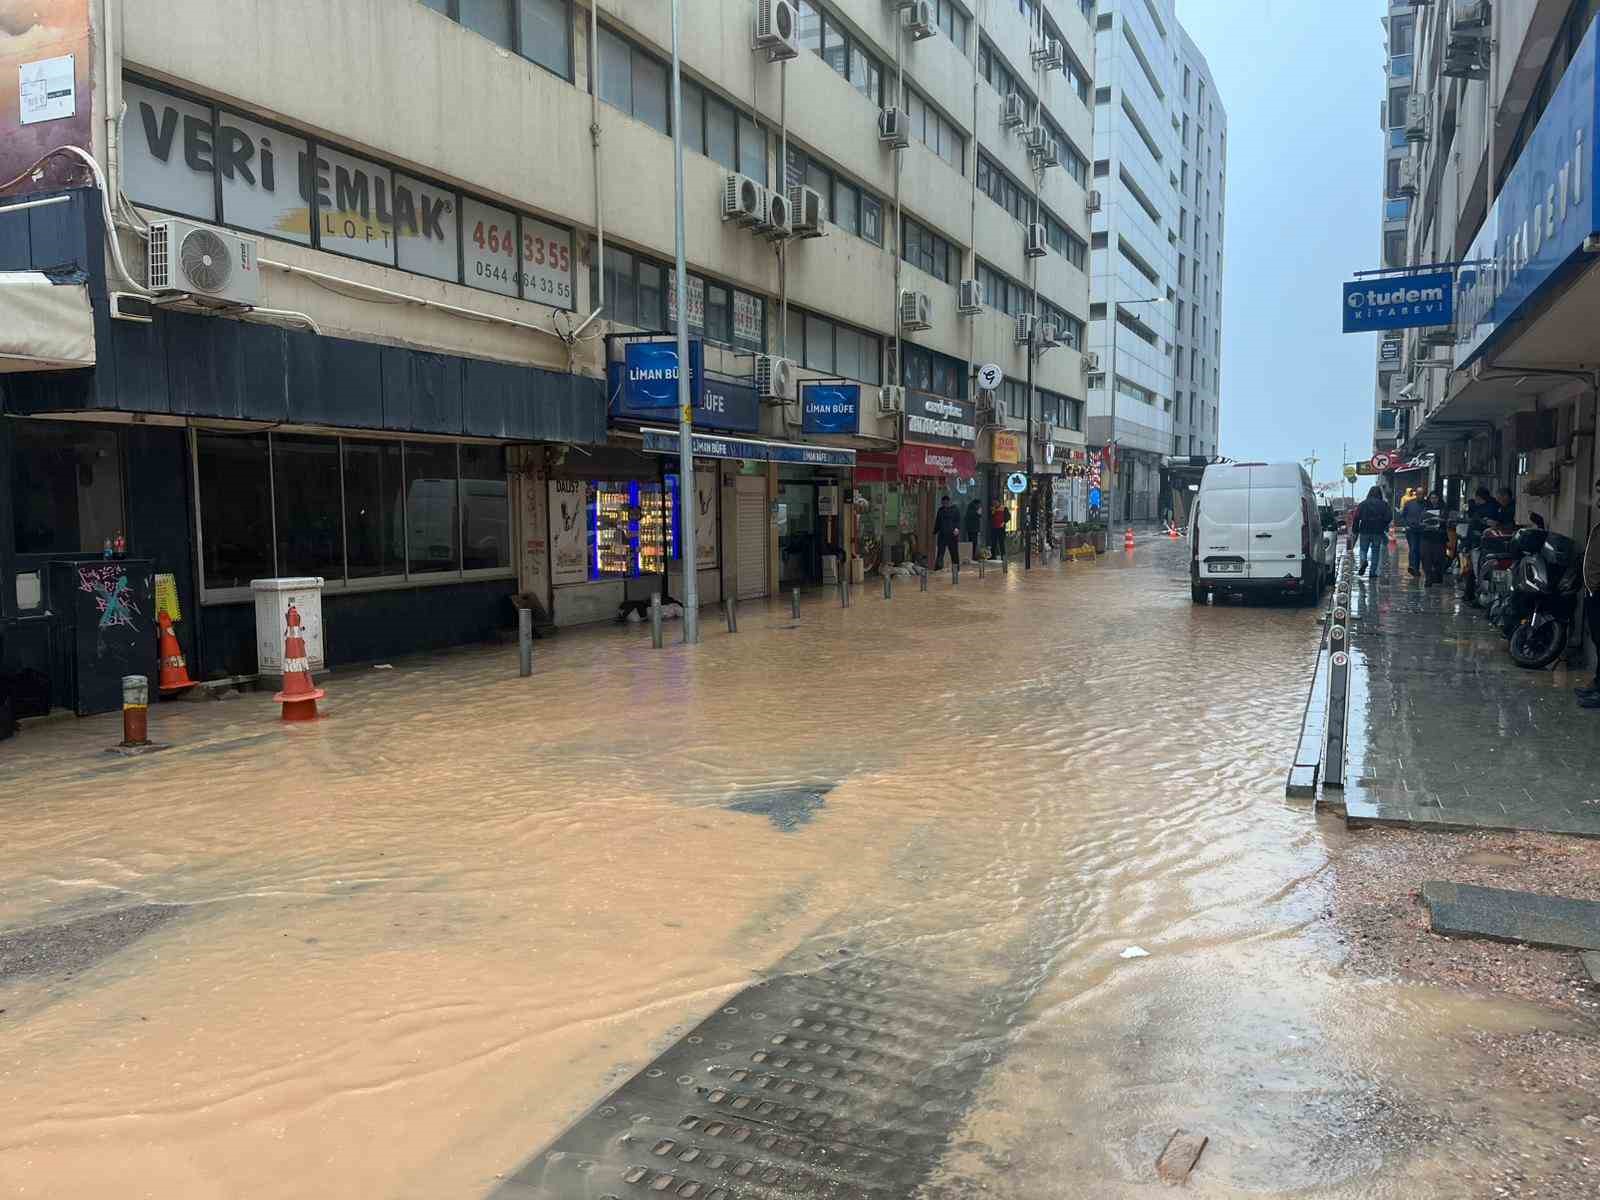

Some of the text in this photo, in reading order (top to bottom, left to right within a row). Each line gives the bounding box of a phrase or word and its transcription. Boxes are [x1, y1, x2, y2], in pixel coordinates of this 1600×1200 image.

[326, 214, 391, 248] LOFT
[473, 221, 513, 257] 464
[476, 260, 507, 284] 0544
[540, 278, 554, 294] 33
[558, 282, 571, 298] 55
[1366, 287, 1443, 306] tudem
[1355, 302, 1443, 319] KİTABEVİ
[630, 366, 693, 380] LİMAN BÜE
[806, 402, 855, 413] LİMAN BÜFE
